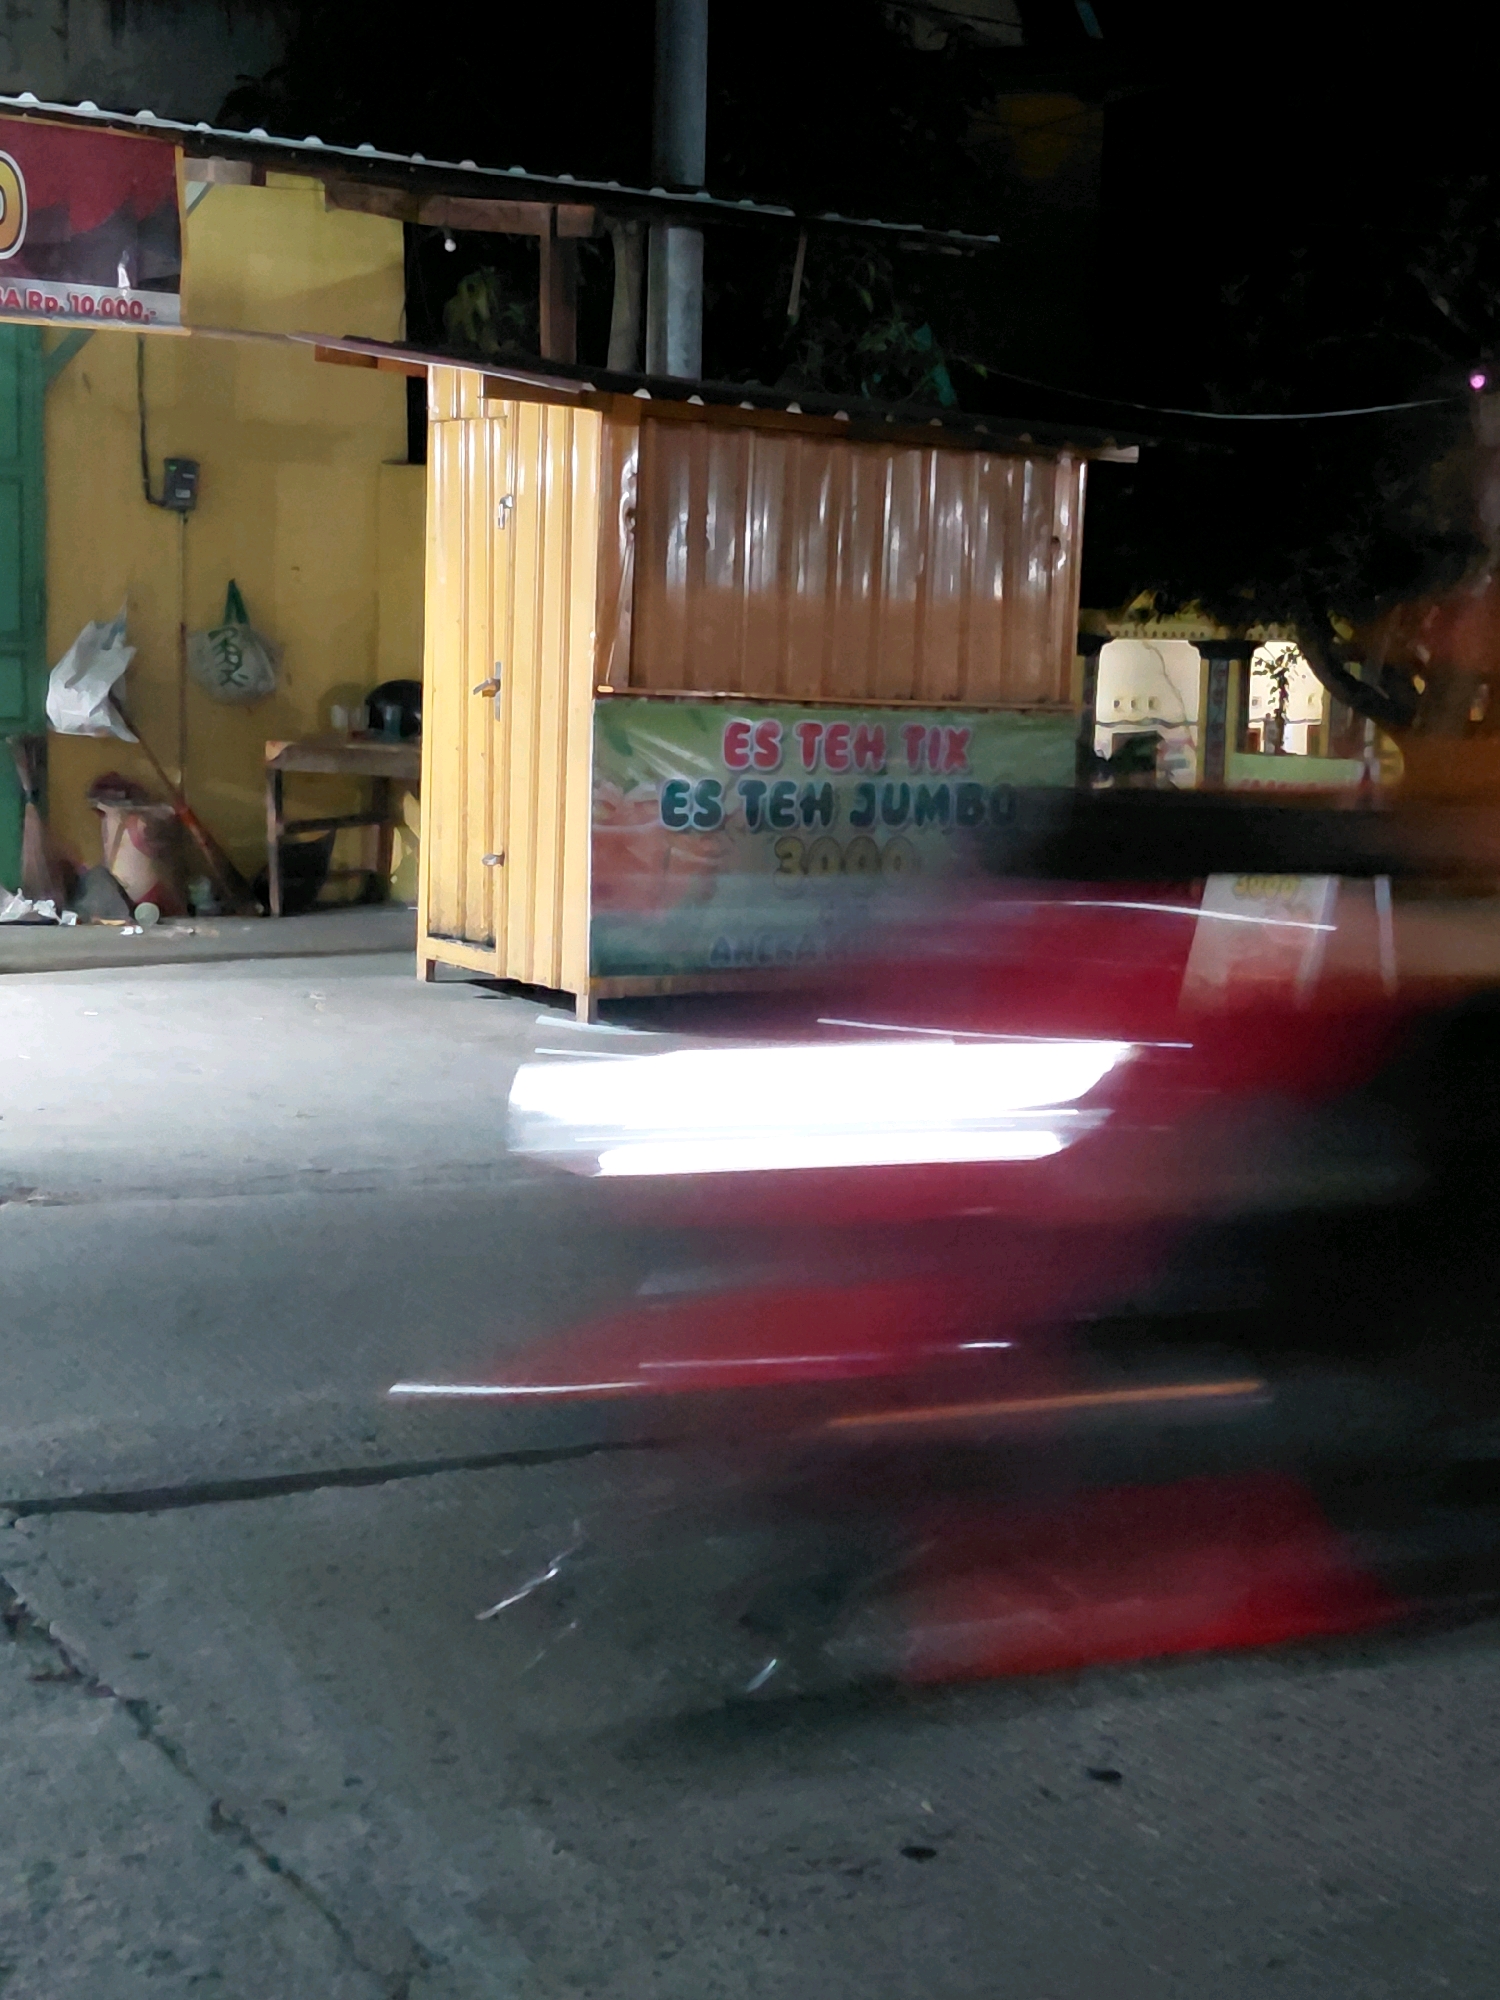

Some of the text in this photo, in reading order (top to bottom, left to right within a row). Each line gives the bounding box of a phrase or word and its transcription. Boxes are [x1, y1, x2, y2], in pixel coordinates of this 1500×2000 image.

[26, 290, 65, 313] Rp.
[723, 719, 972, 774] ES TEH TIX
[660, 778, 1017, 831] ES TEH JUMBO
[773, 835, 916, 885] 3000
